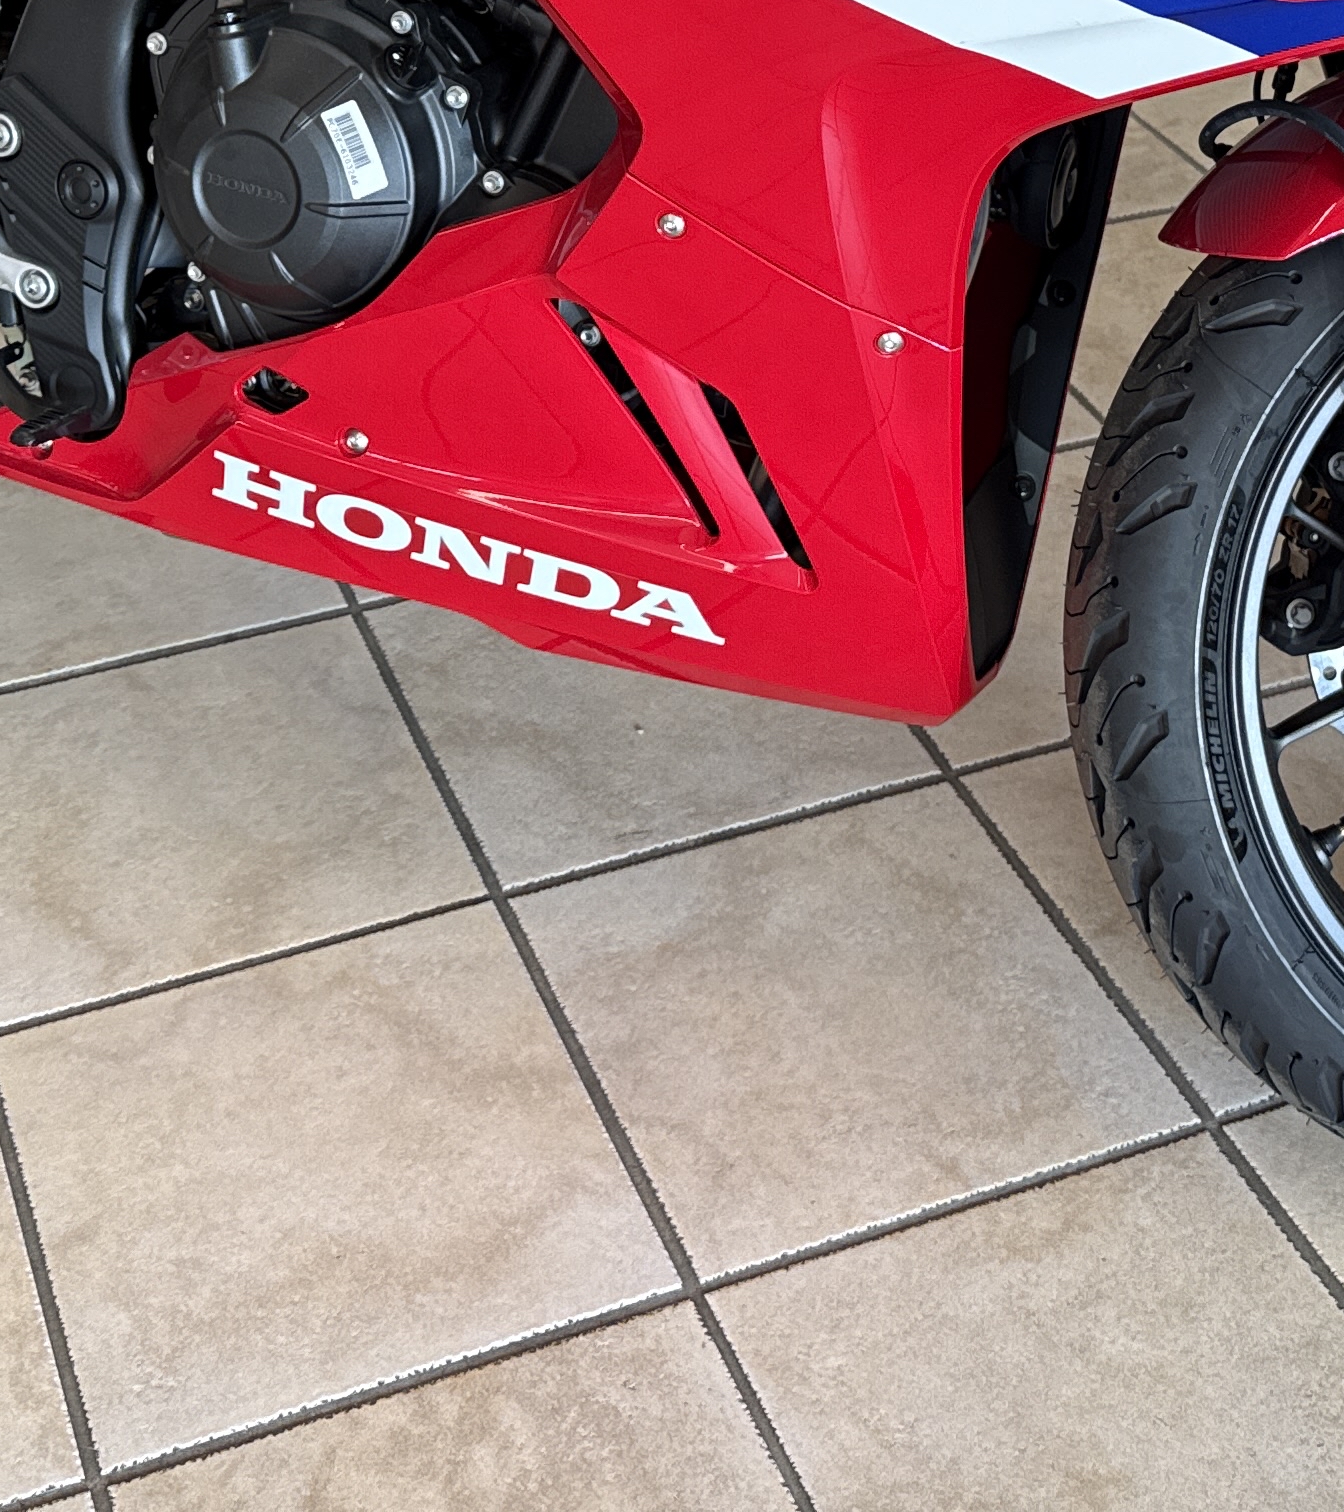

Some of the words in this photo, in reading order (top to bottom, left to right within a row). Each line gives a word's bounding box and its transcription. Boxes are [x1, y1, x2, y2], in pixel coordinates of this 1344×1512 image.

[208, 171, 290, 204] HONDA
[1227, 504, 1240, 524] 17
[211, 450, 725, 646] HONDA
[1218, 535, 1233, 561] ZR
[1205, 569, 1224, 643] 120/70
[1205, 670, 1236, 812] MICHELIN
